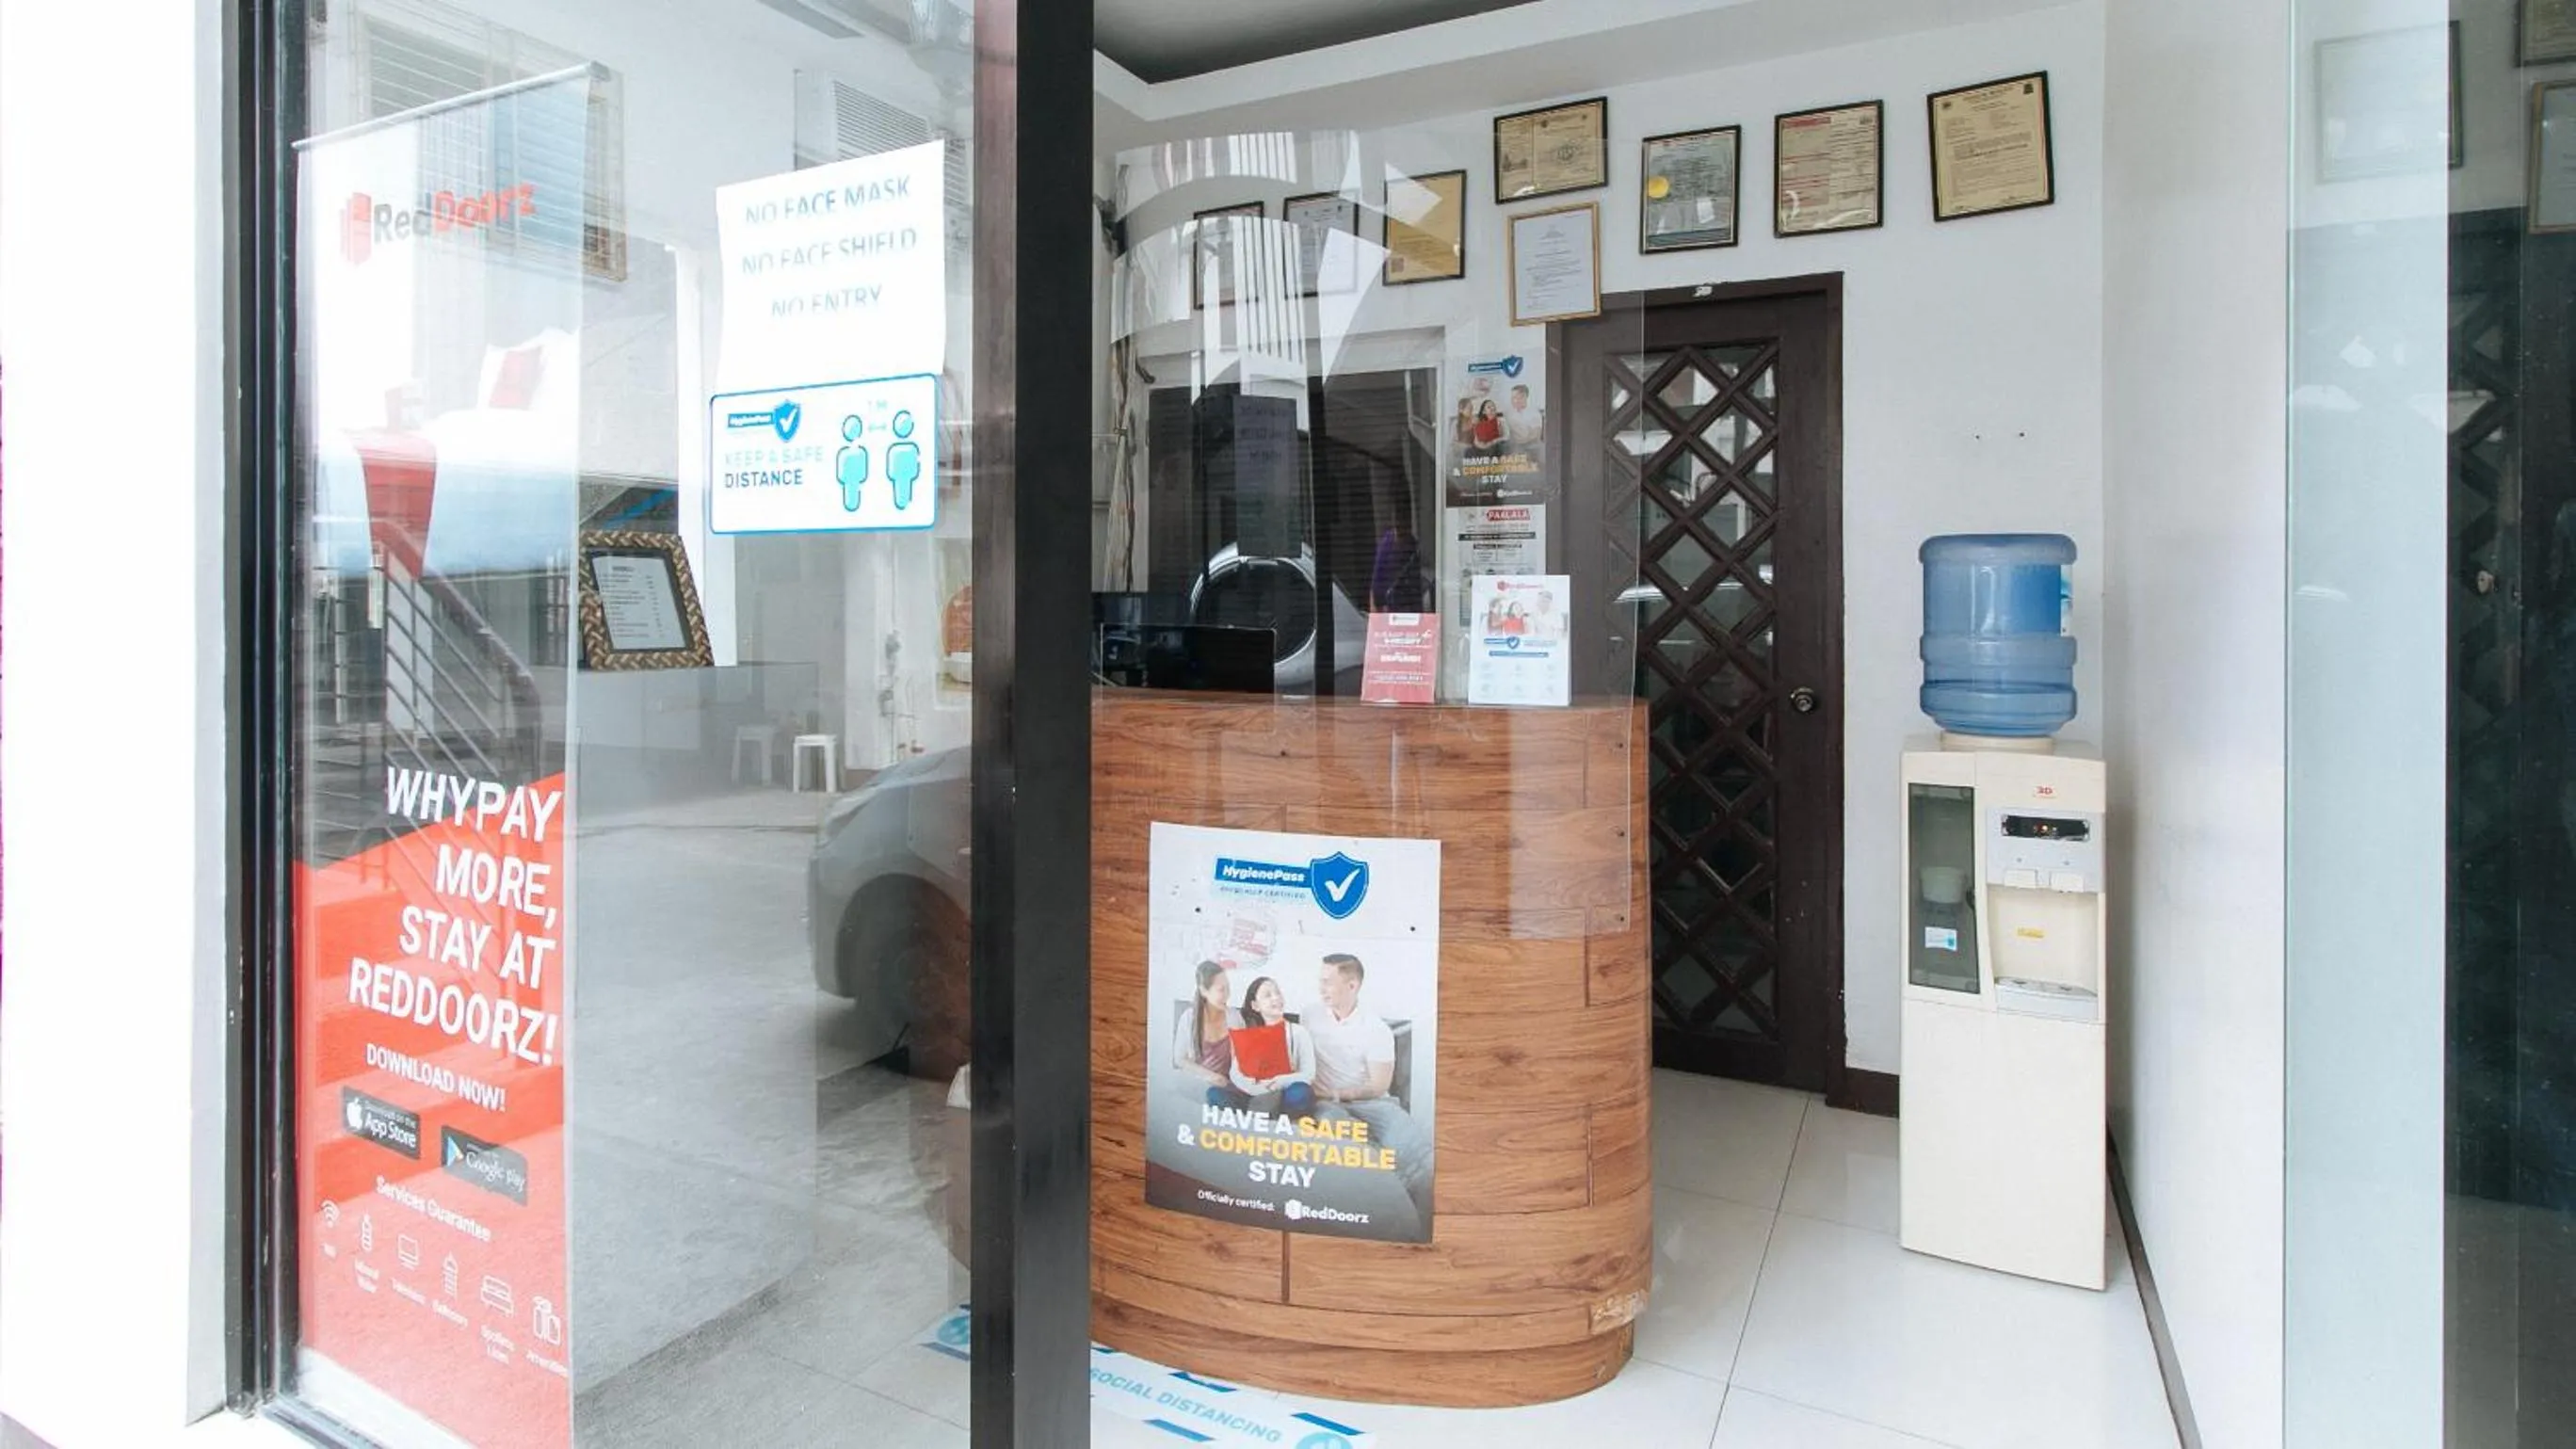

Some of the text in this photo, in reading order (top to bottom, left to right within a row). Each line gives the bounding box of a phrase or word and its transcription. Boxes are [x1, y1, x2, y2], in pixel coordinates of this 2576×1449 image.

[374, 183, 537, 244] RedDoorz
[746, 175, 910, 223] NO FACE MASK
[742, 228, 916, 274] NO FACE SHIELD
[771, 284, 882, 317] NO ENTRY
[724, 445, 823, 466] KEEP A SAFE
[724, 469, 803, 488] DISTANCE
[436, 844, 556, 928] MORE,
[1222, 865, 1305, 881] HygienePass
[400, 906, 555, 990] STAY AT
[349, 958, 557, 1066] REDDOORZ!
[367, 1043, 506, 1113] DOWNLOAD NOW!
[365, 1112, 416, 1148] App Store
[1202, 1104, 1368, 1142] HAVE A SAFE
[1177, 1124, 1396, 1169] & COMFORTABLE
[1248, 1161, 1315, 1188] STAY
[377, 1176, 491, 1241] Services Guarantee
[1198, 1189, 1234, 1207] Officially
[1302, 1206, 1370, 1224] RedDoorz
[1090, 1367, 1281, 1442] SOCIAL DISTANCING
